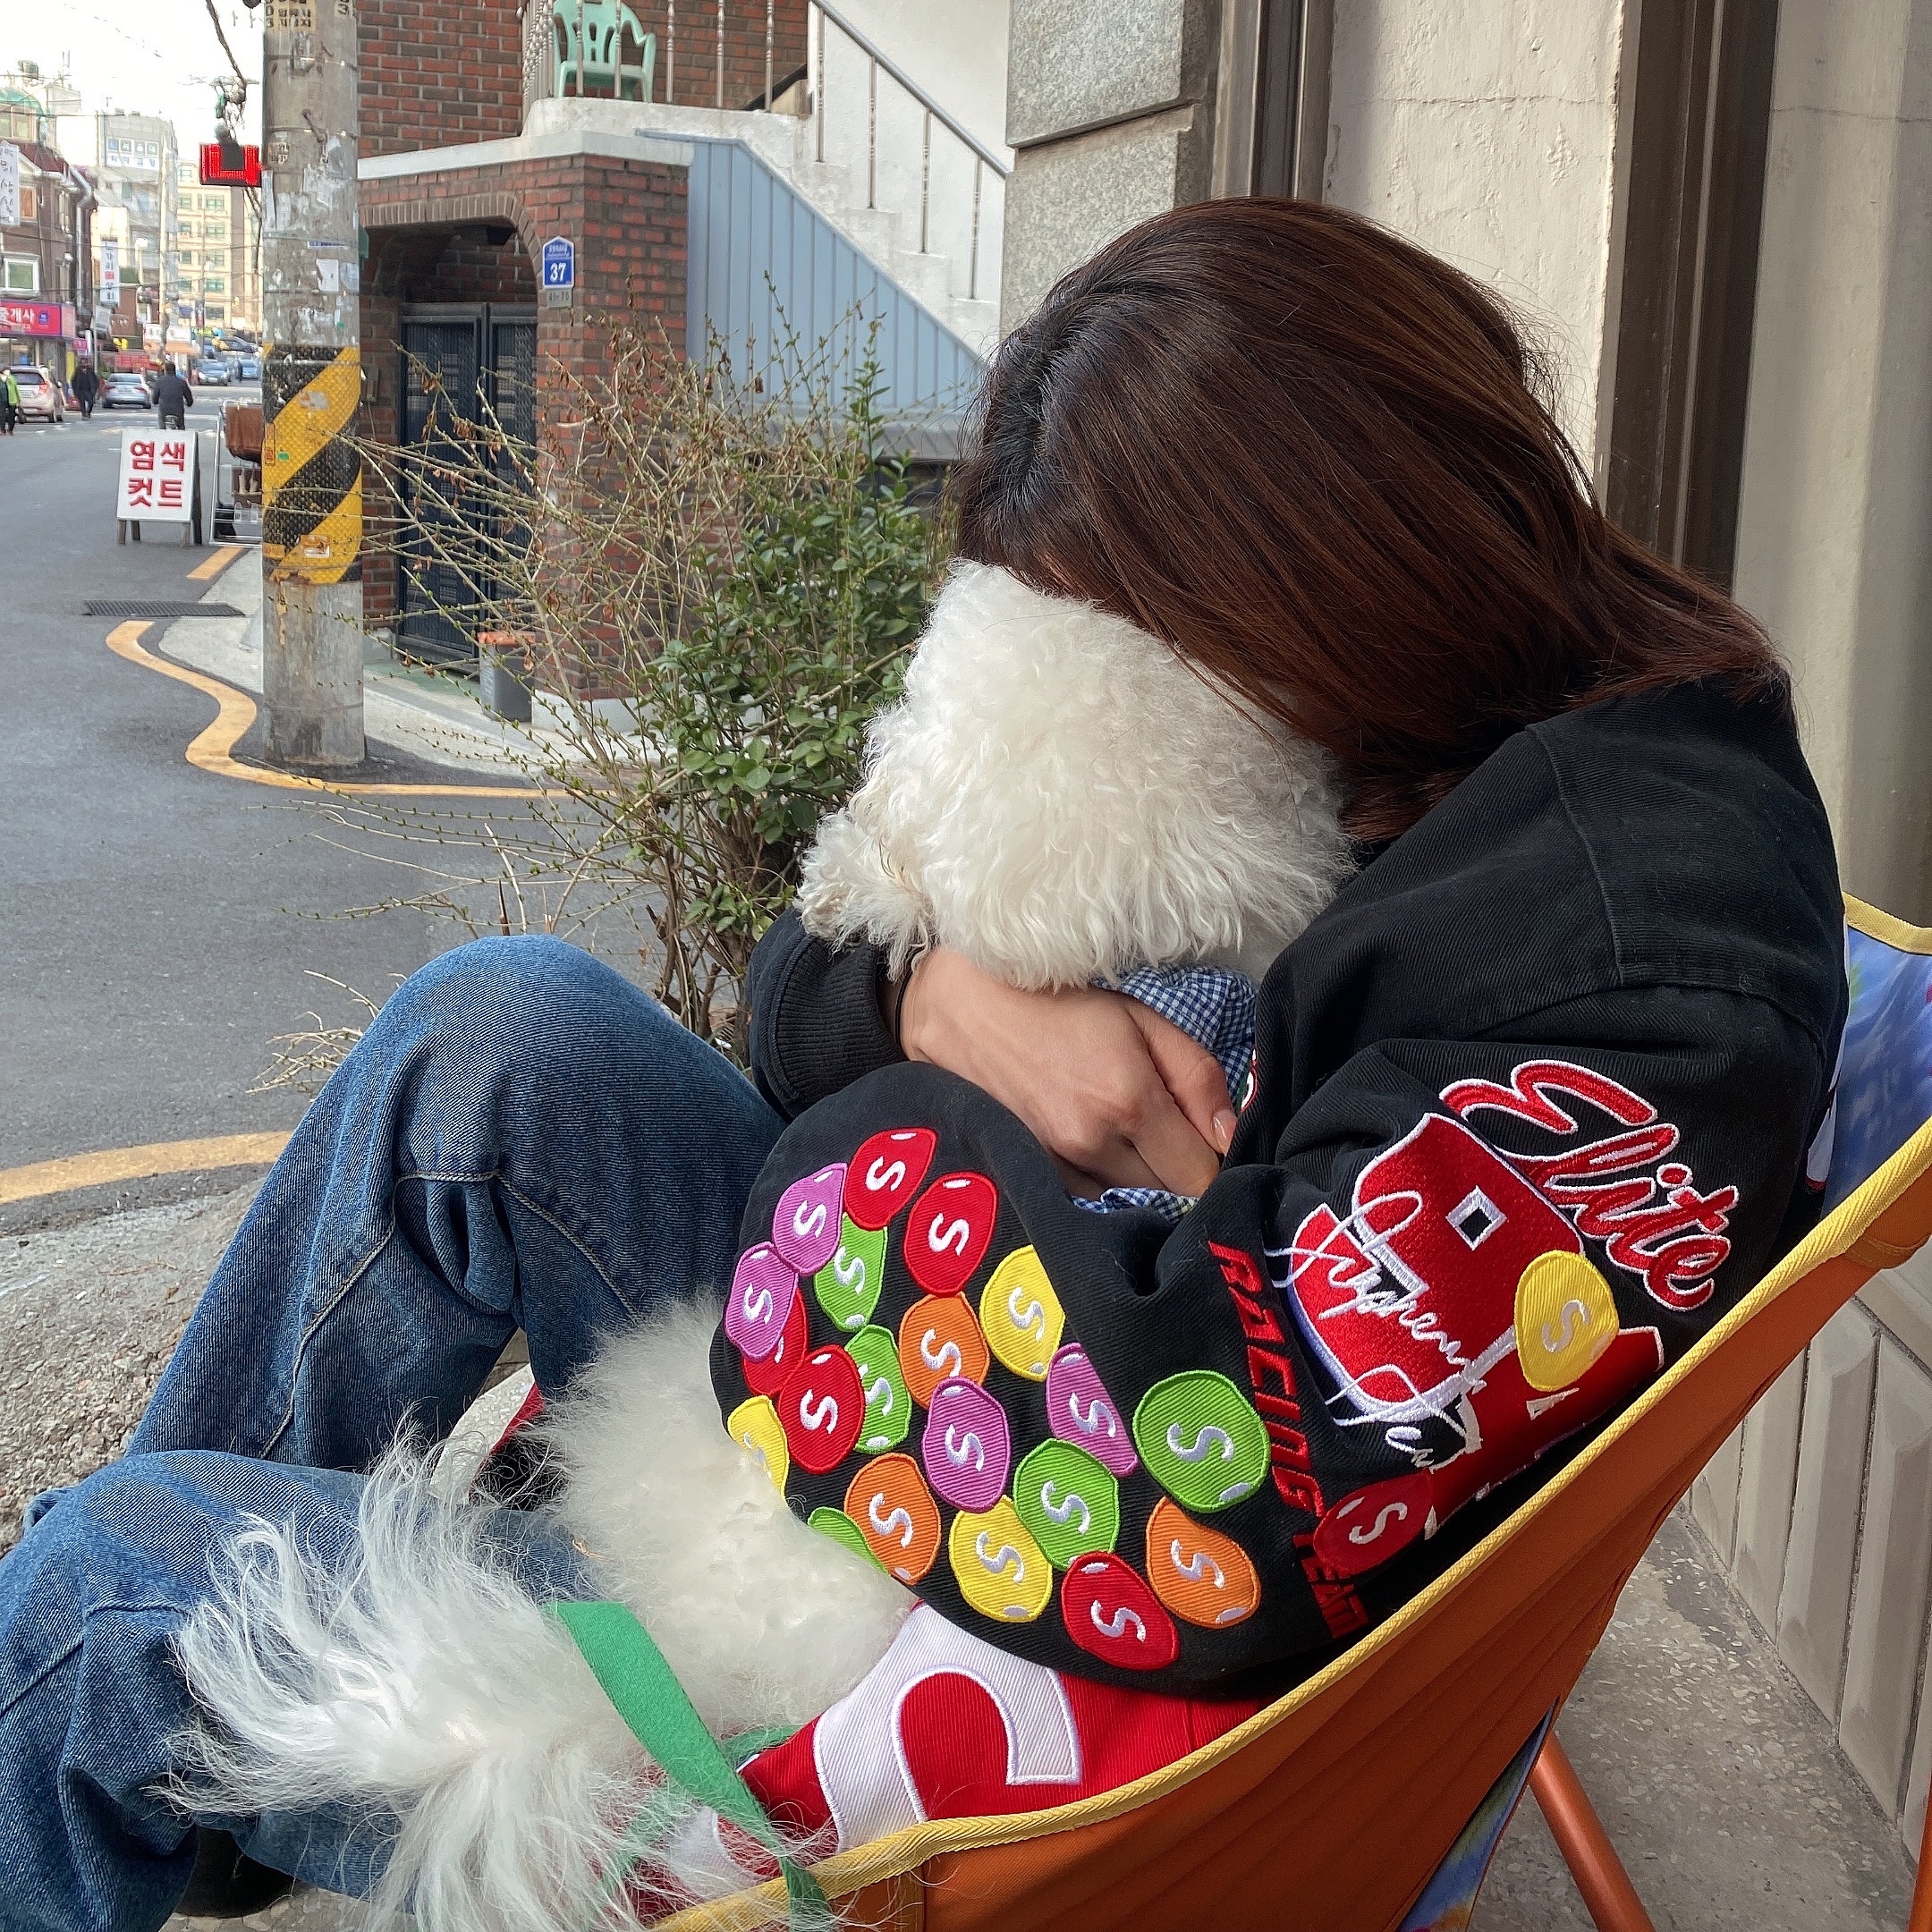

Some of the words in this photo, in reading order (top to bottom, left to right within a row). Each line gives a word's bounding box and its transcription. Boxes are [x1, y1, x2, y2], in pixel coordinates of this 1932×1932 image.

[549, 262, 567, 283] 37
[130, 440, 185, 472] 염색
[128, 478, 182, 508] 컷트
[866, 1156, 906, 1191] S
[1439, 1058, 1740, 1312] Elite
[793, 1199, 827, 1238] S
[928, 1213, 970, 1256] S
[834, 1244, 866, 1294] S
[742, 1284, 774, 1324] S
[1007, 1285, 1046, 1342] S
[1542, 1298, 1589, 1353] S
[920, 1327, 963, 1378] S
[1207, 1240, 1326, 1519] RACING
[801, 1389, 840, 1435] S
[1067, 1392, 1118, 1439] S
[944, 1424, 987, 1472] S
[1165, 1421, 1235, 1463] S
[868, 1493, 914, 1548] S
[1038, 1480, 1092, 1536] S
[1348, 1502, 1408, 1545] S
[974, 1530, 1026, 1585] S
[1170, 1538, 1226, 1590] S
[1090, 1599, 1147, 1643] S
